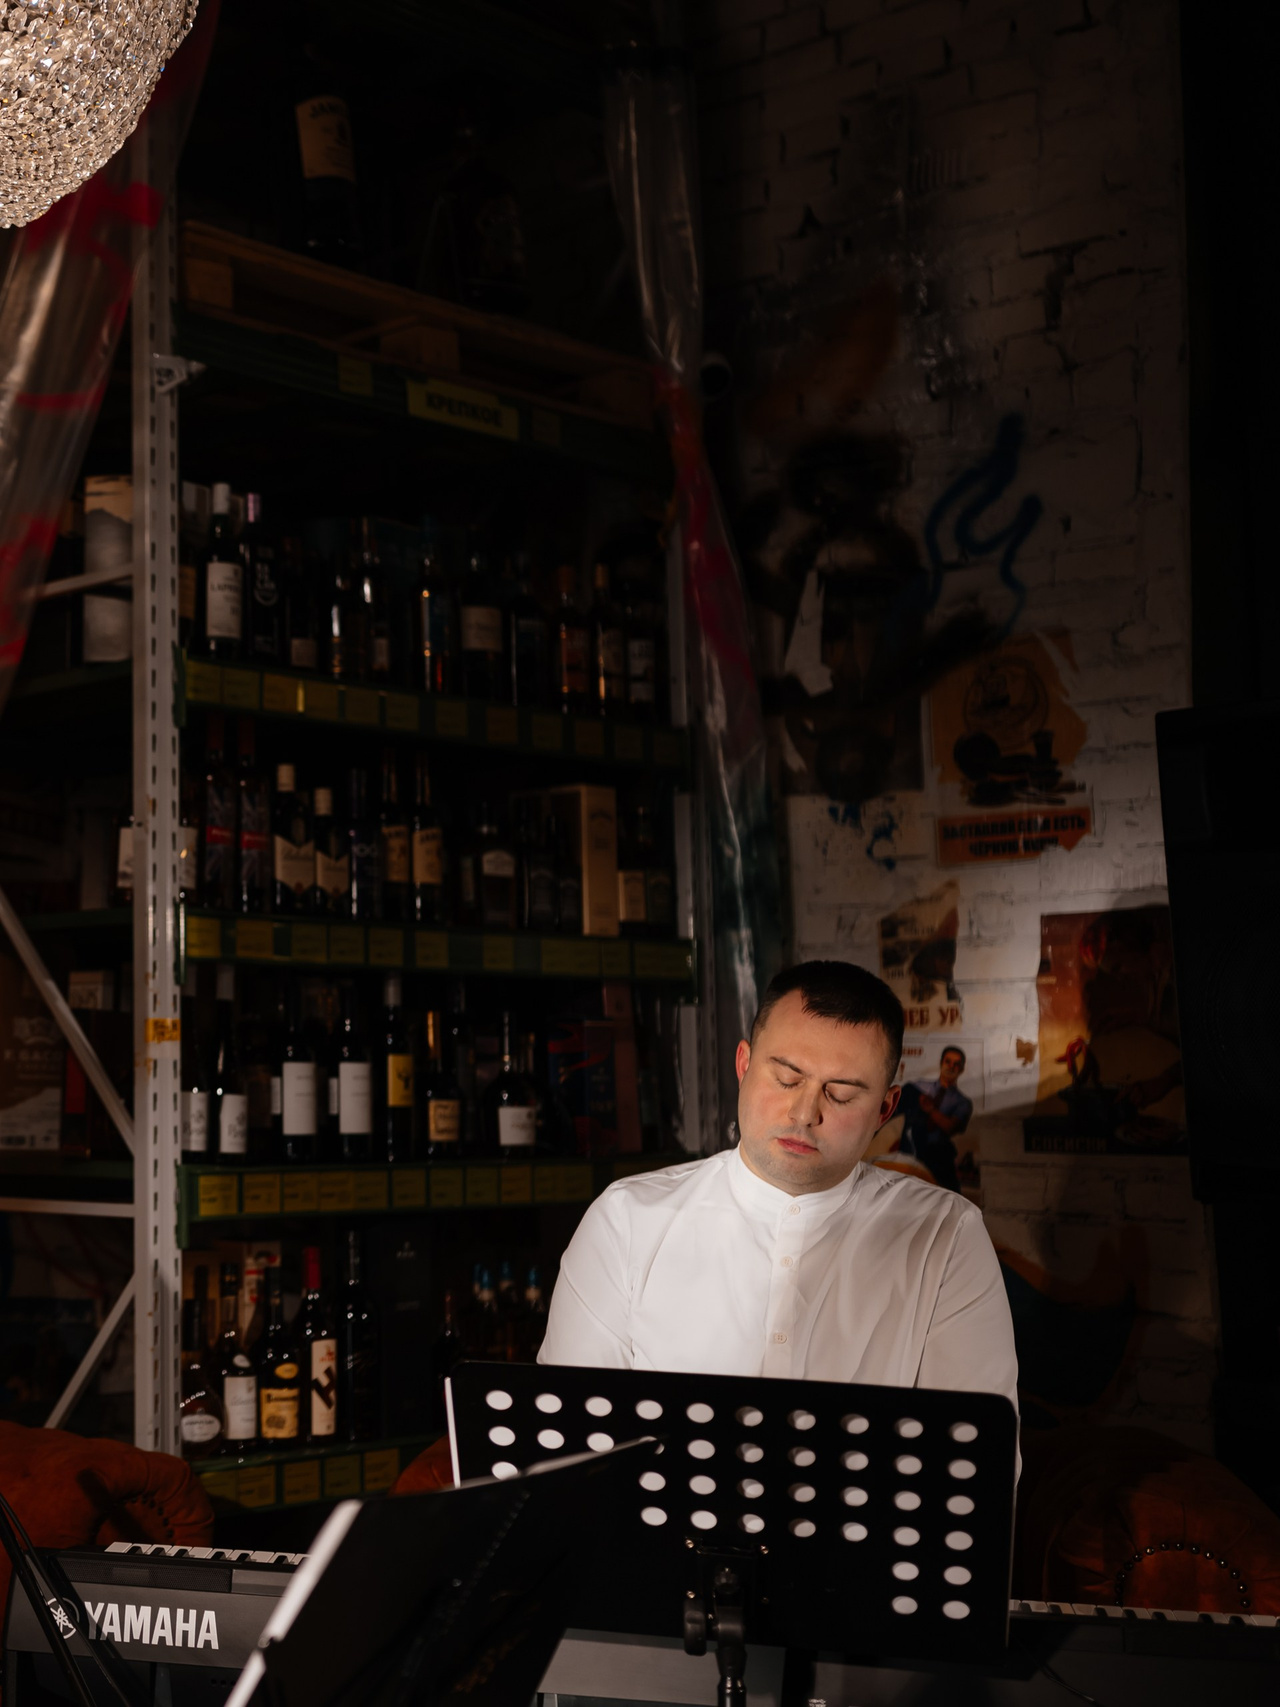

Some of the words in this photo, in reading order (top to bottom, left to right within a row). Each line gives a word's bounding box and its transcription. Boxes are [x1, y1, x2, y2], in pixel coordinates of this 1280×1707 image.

[425, 391, 503, 428] КРЕПКОЕ
[1053, 814, 1087, 832] ЕСТЬ
[937, 1005, 963, 1026] УР
[1031, 1134, 1107, 1153] СОСИСКИ
[83, 1600, 220, 1651] YAMAHA
